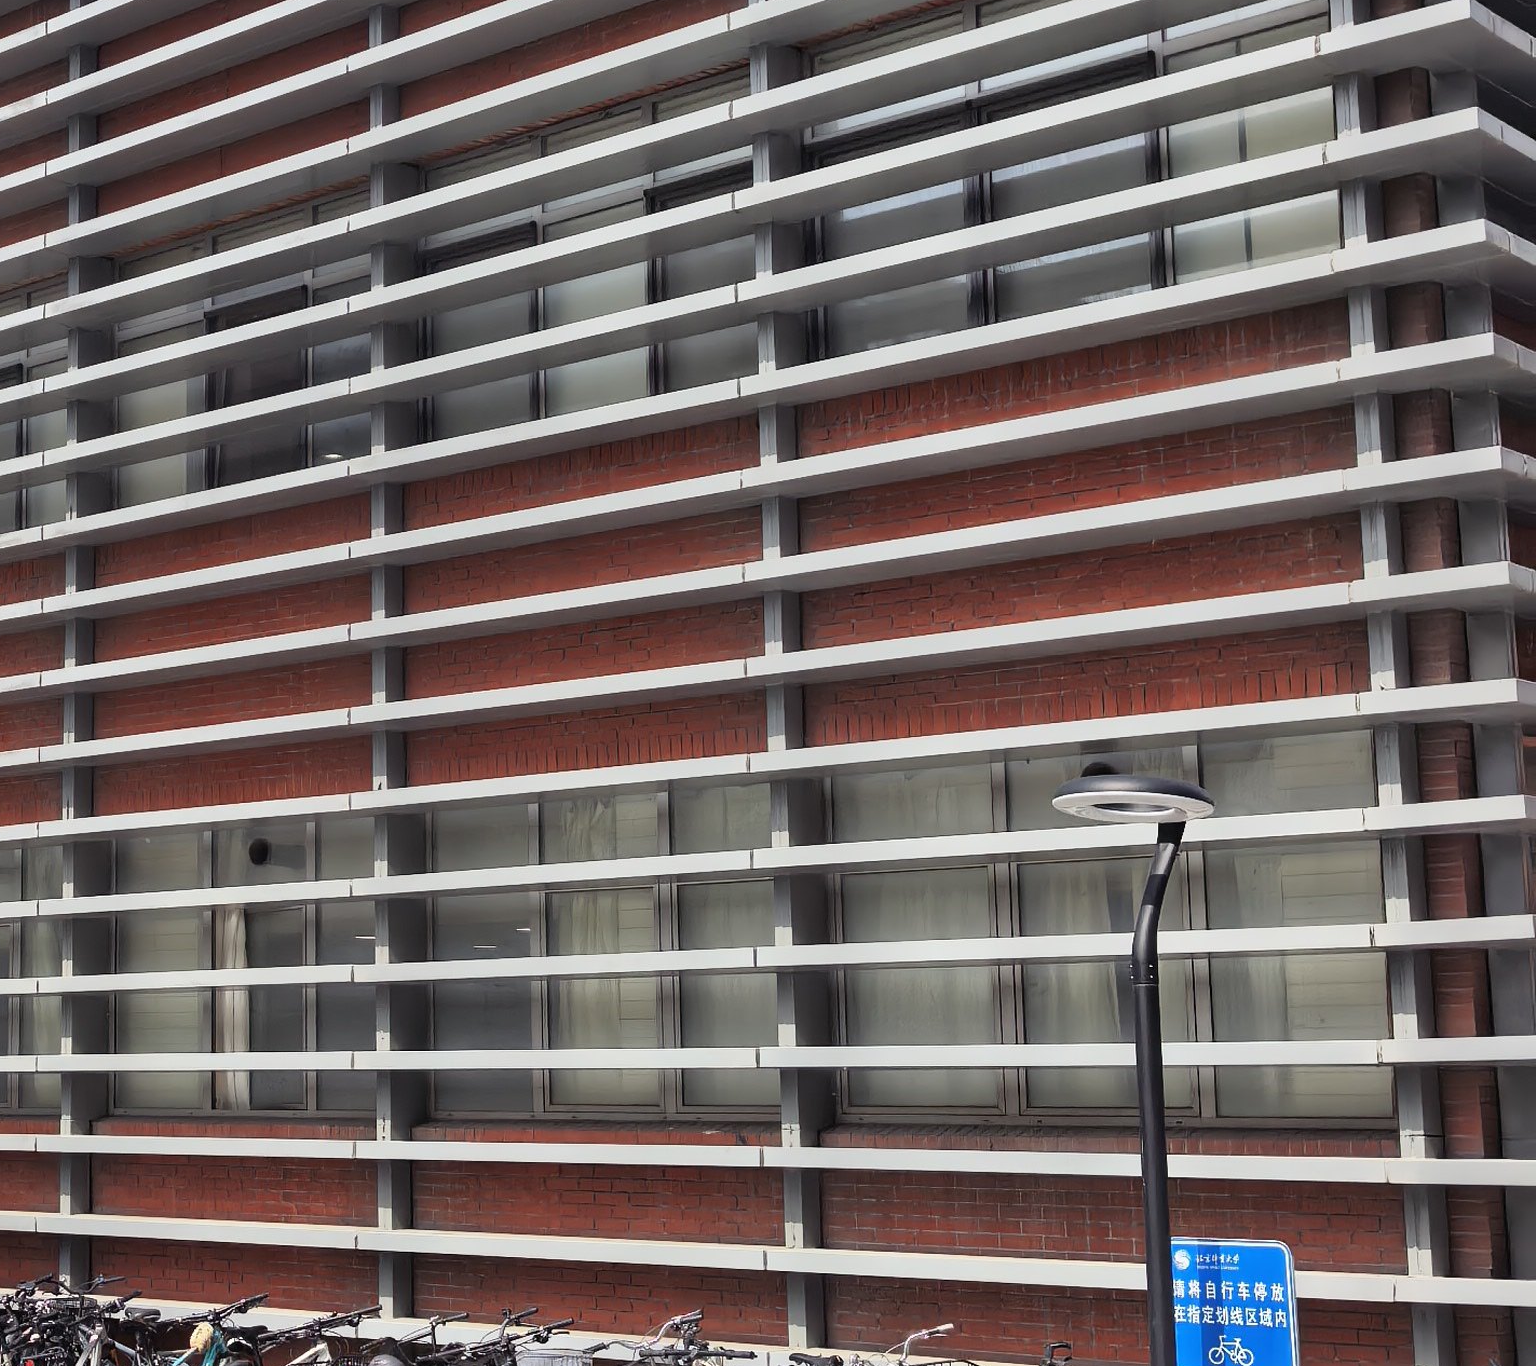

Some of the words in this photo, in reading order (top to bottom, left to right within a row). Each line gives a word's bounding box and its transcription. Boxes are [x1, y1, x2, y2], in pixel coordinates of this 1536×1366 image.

[1173, 1279, 1285, 1302] 请将自行车停放
[1174, 1304, 1287, 1327] 在指定划线区域内
